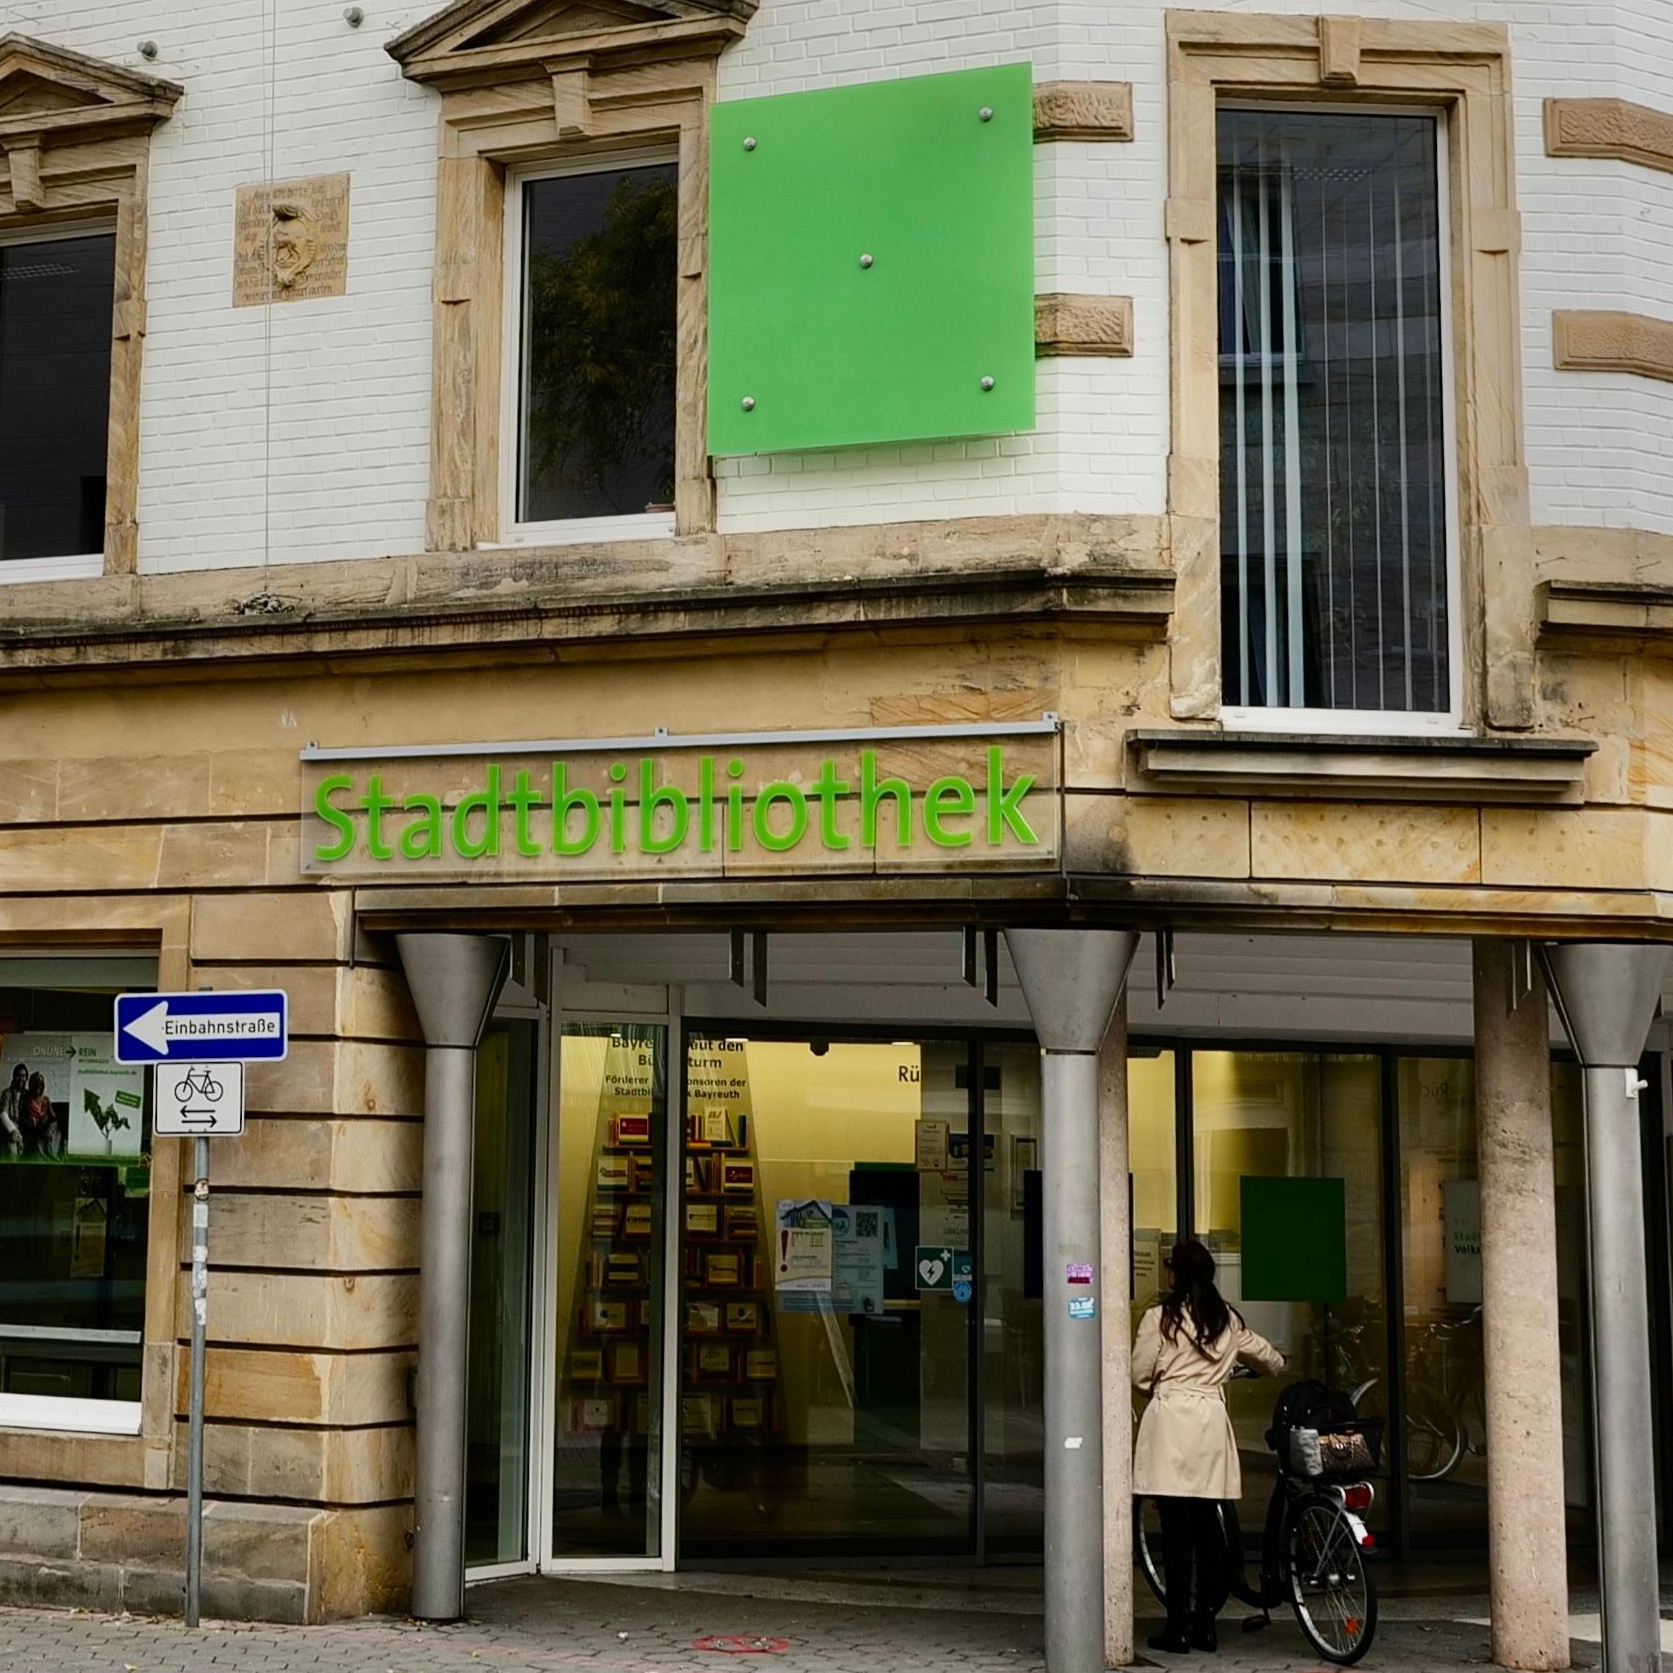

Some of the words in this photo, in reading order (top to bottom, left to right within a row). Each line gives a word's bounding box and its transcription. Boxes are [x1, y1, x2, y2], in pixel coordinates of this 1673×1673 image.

[314, 744, 1041, 861] Stadtbibliothek
[165, 1018, 276, 1035] Einbahnstraße
[612, 1037, 654, 1052] Bayre
[718, 1041, 744, 1052] den
[688, 1057, 722, 1068] turm
[605, 1075, 649, 1084] Förderer
[730, 1078, 747, 1087] der
[898, 1065, 920, 1082] Rü
[694, 1090, 740, 1099] Bayreuth
